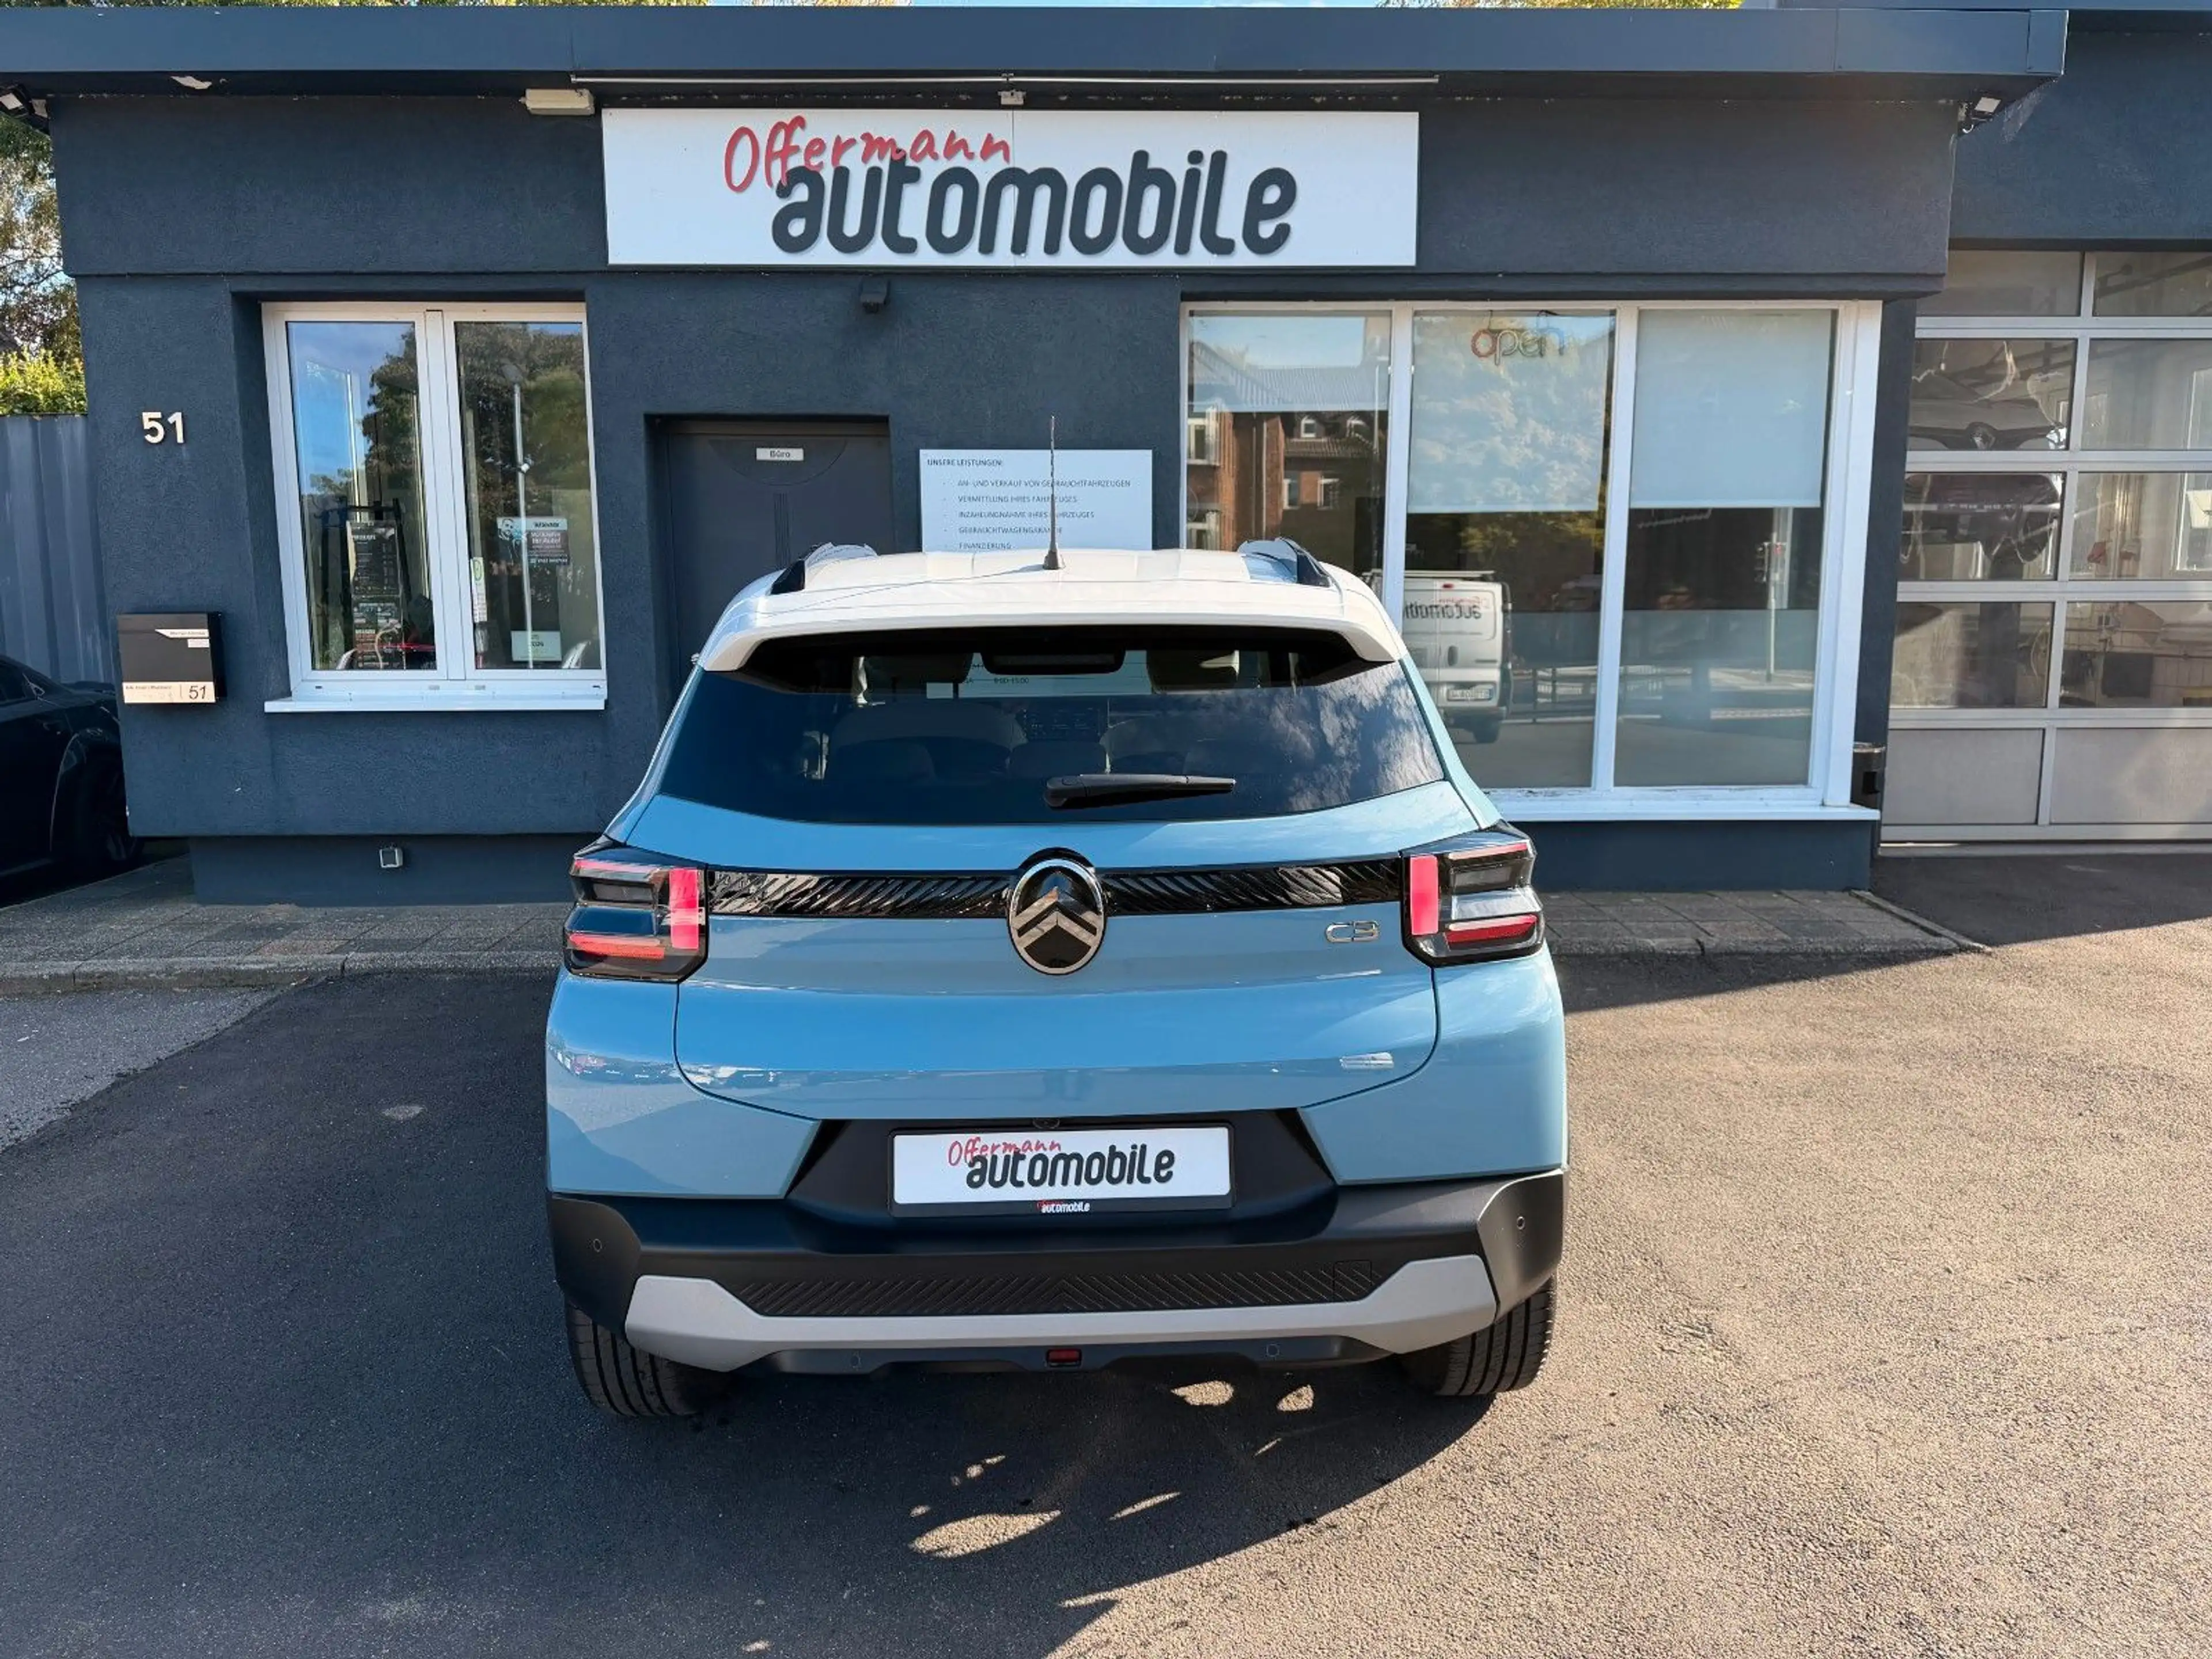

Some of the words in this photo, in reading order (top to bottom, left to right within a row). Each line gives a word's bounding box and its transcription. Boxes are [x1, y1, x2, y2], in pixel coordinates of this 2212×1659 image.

[725, 115, 1011, 194] Offermann
[771, 149, 1297, 255] automobile
[1471, 328, 1565, 366] open
[142, 411, 184, 443] 51
[770, 450, 790, 458] Büro
[990, 479, 1022, 487] VERKAUF
[1024, 479, 1040, 487] VON
[188, 685, 207, 700] 51
[1325, 921, 1380, 943] C3
[948, 1137, 1061, 1166] Offermann
[966, 1143, 1175, 1189] automobile
[1041, 1200, 1090, 1213] automobile
